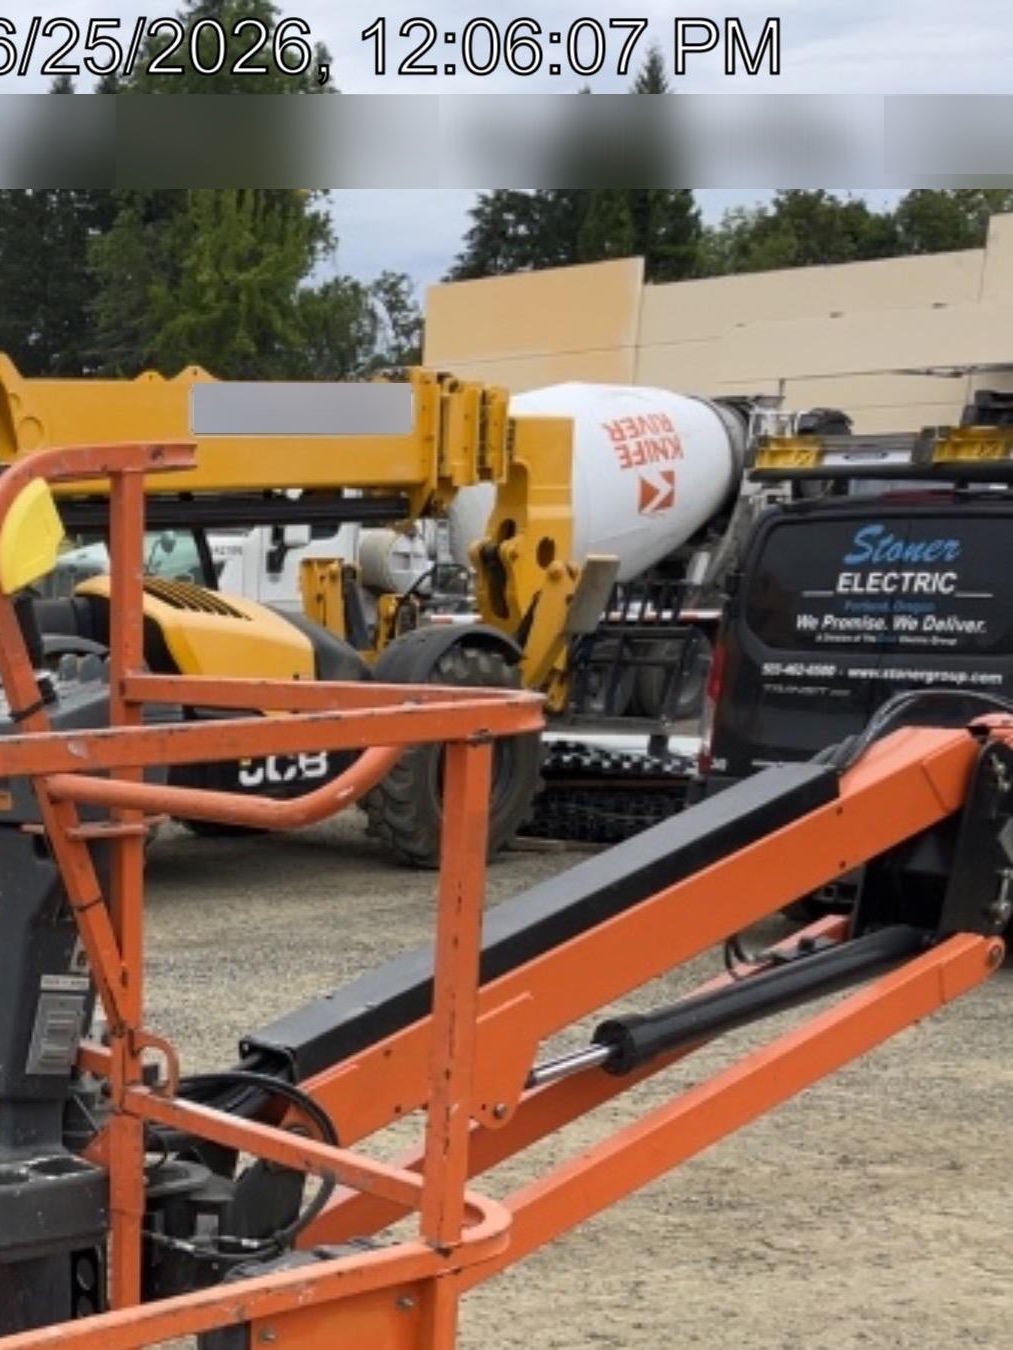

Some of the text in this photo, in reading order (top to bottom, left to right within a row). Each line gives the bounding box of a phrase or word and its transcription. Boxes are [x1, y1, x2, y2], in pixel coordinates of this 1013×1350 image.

[600, 412, 676, 442] RIVER
[614, 434, 685, 469] KNIFE
[843, 523, 962, 565] Stoner
[835, 571, 958, 595] ELECTRIC
[795, 613, 988, 634] We Promise. We Deliver.
